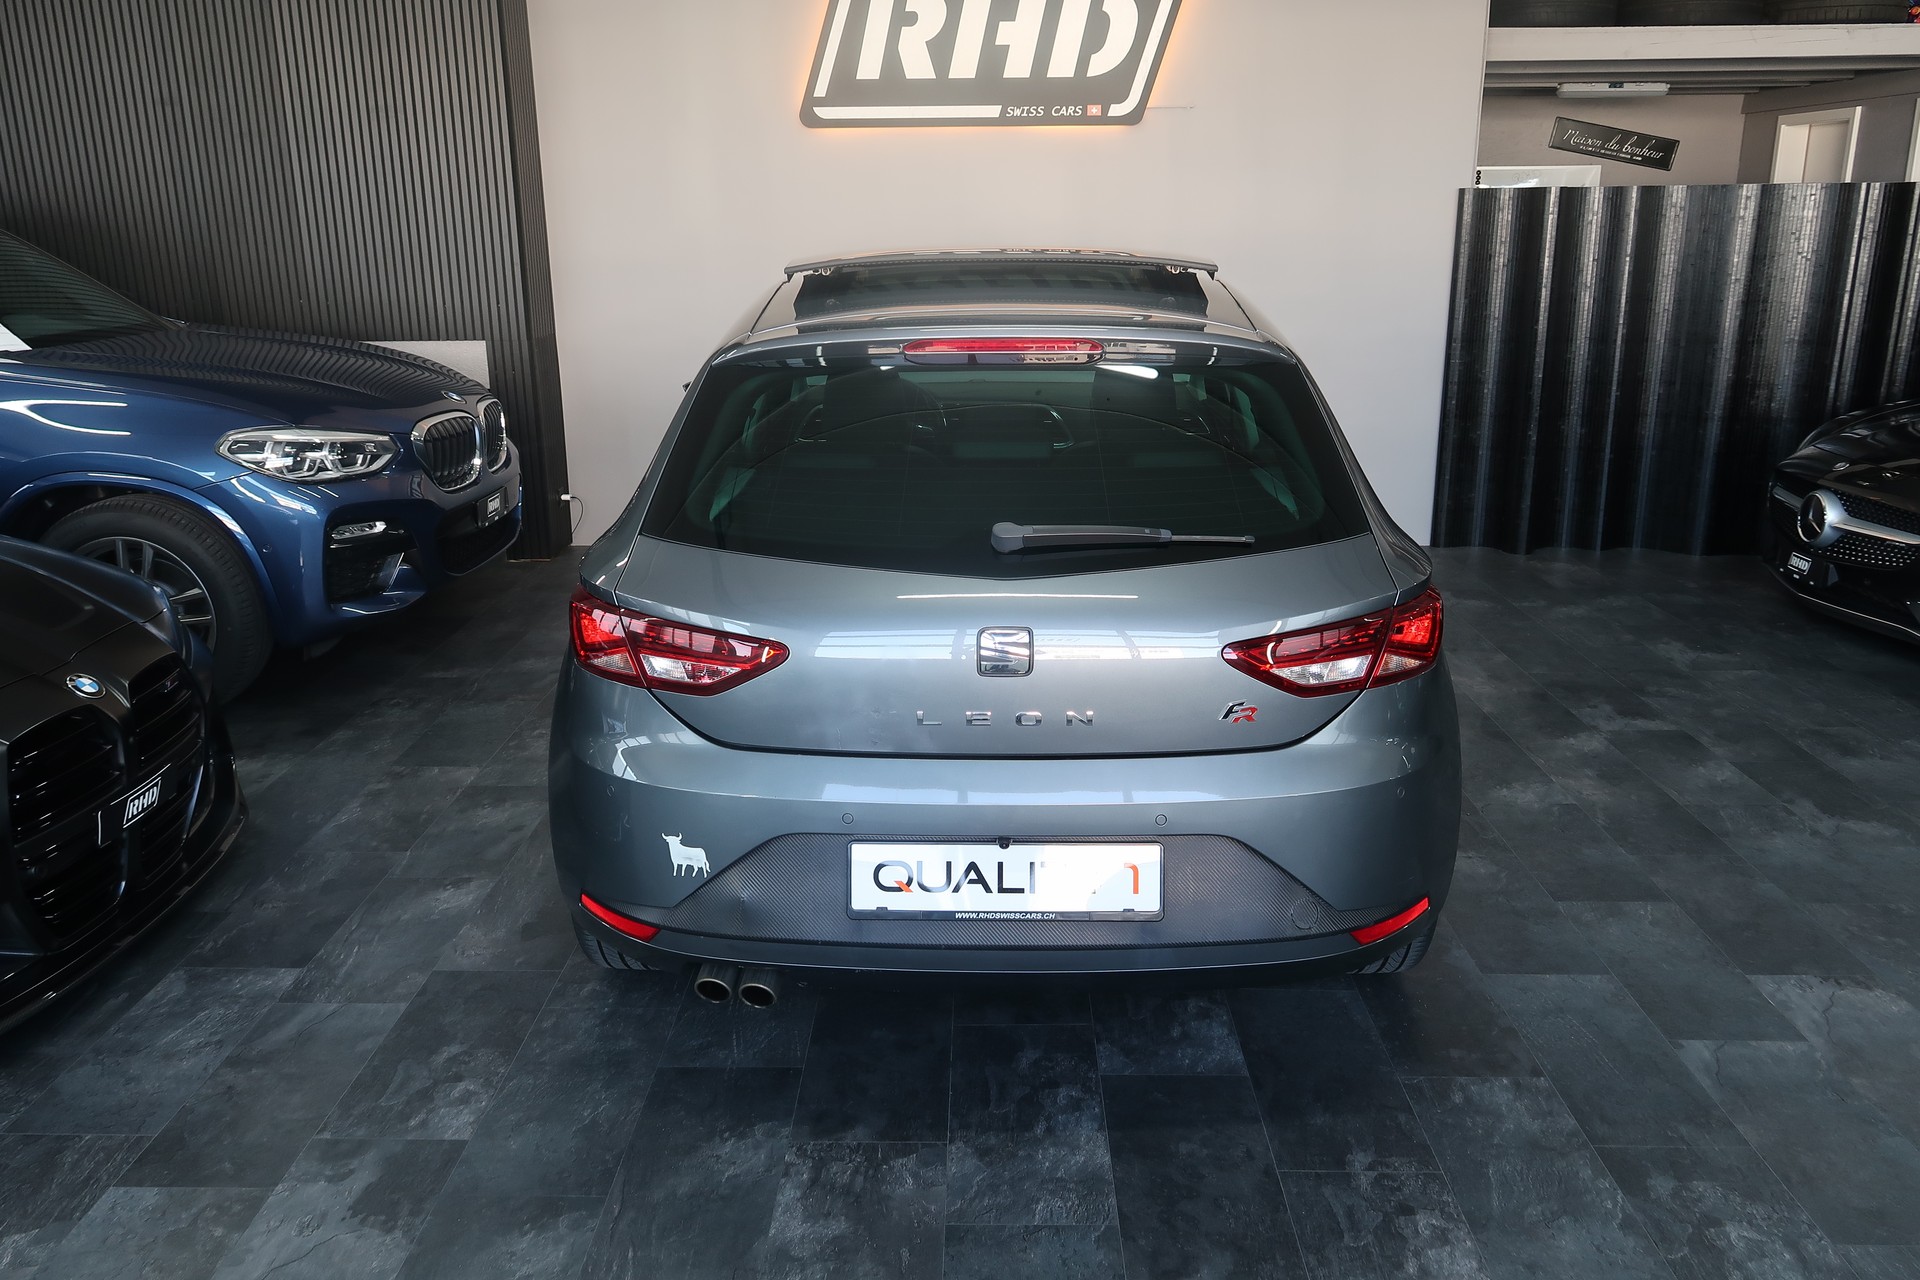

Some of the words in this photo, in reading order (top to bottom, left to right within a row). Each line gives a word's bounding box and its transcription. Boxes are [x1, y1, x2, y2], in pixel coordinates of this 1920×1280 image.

[856, 0, 1140, 80] RHD
[1005, 106, 1044, 117] SWISS
[1051, 105, 1083, 116] CARS
[1563, 129, 1602, 146] Maison
[1605, 134, 1621, 151] du
[1622, 135, 1664, 159] bonheur
[1790, 556, 1809, 571] RHD
[916, 710, 1094, 727] LEON
[1218, 699, 1259, 724] FR
[128, 786, 158, 820] RHD
[955, 912, 1056, 920] WWW.RHDSWISSCARS.CH
